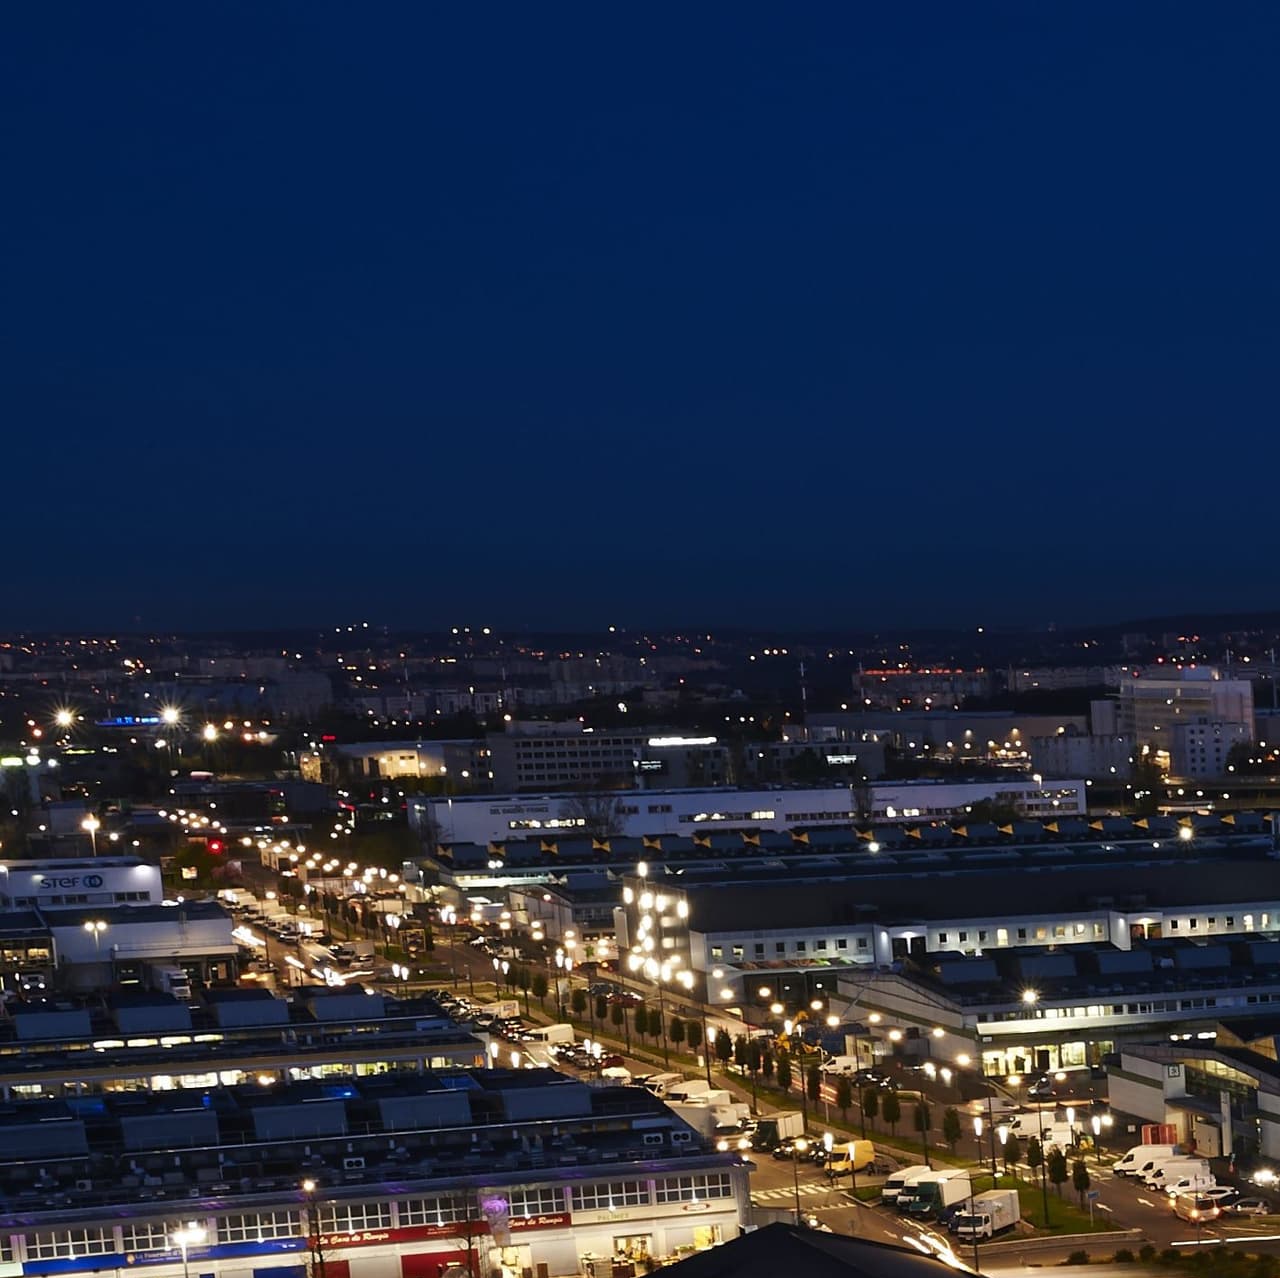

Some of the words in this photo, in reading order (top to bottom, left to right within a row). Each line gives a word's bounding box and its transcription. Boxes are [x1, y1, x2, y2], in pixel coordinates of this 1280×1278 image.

[538, 1216, 564, 1224] Rungis
[351, 1234, 361, 1242] de
[362, 1232, 390, 1241] Rungis
